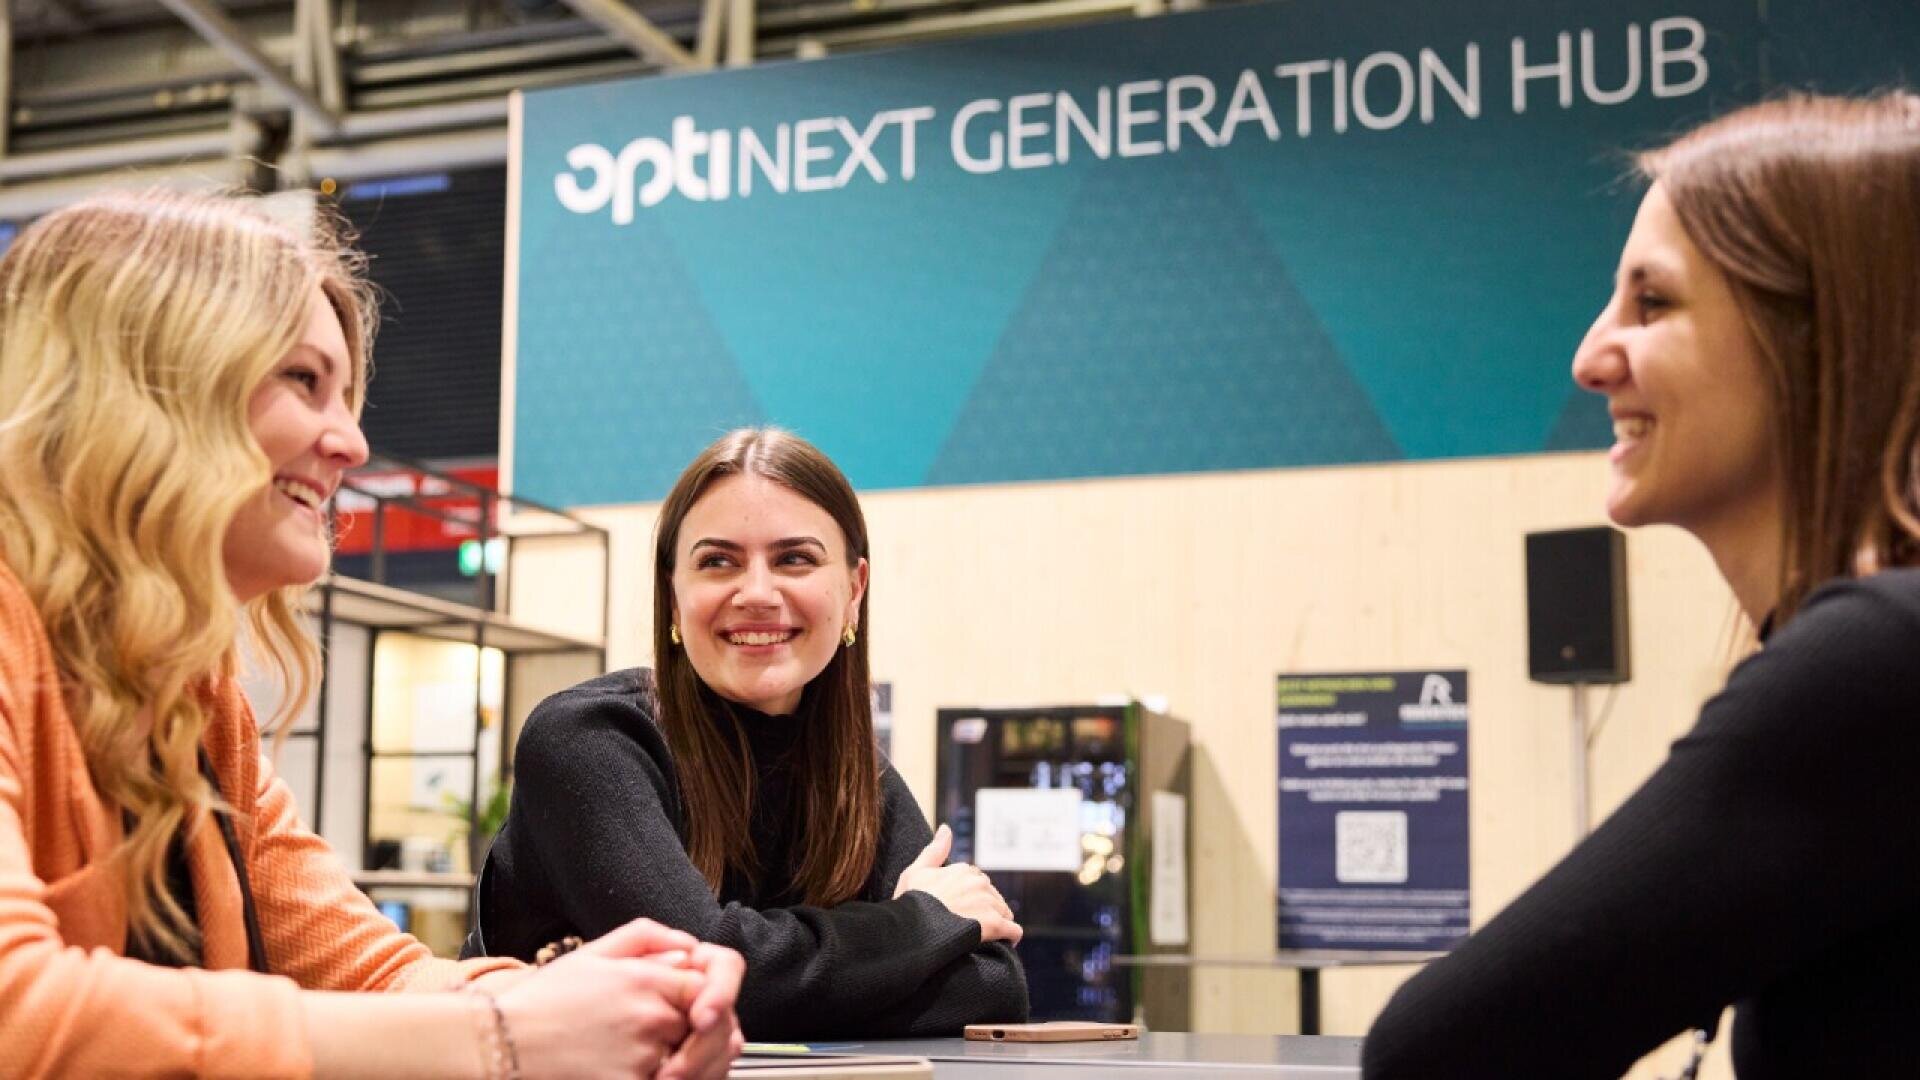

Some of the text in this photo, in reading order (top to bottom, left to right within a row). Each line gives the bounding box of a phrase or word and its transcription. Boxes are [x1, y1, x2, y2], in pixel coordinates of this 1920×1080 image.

[554, 16, 1709, 225] opti NEXT GENERATION HUB
